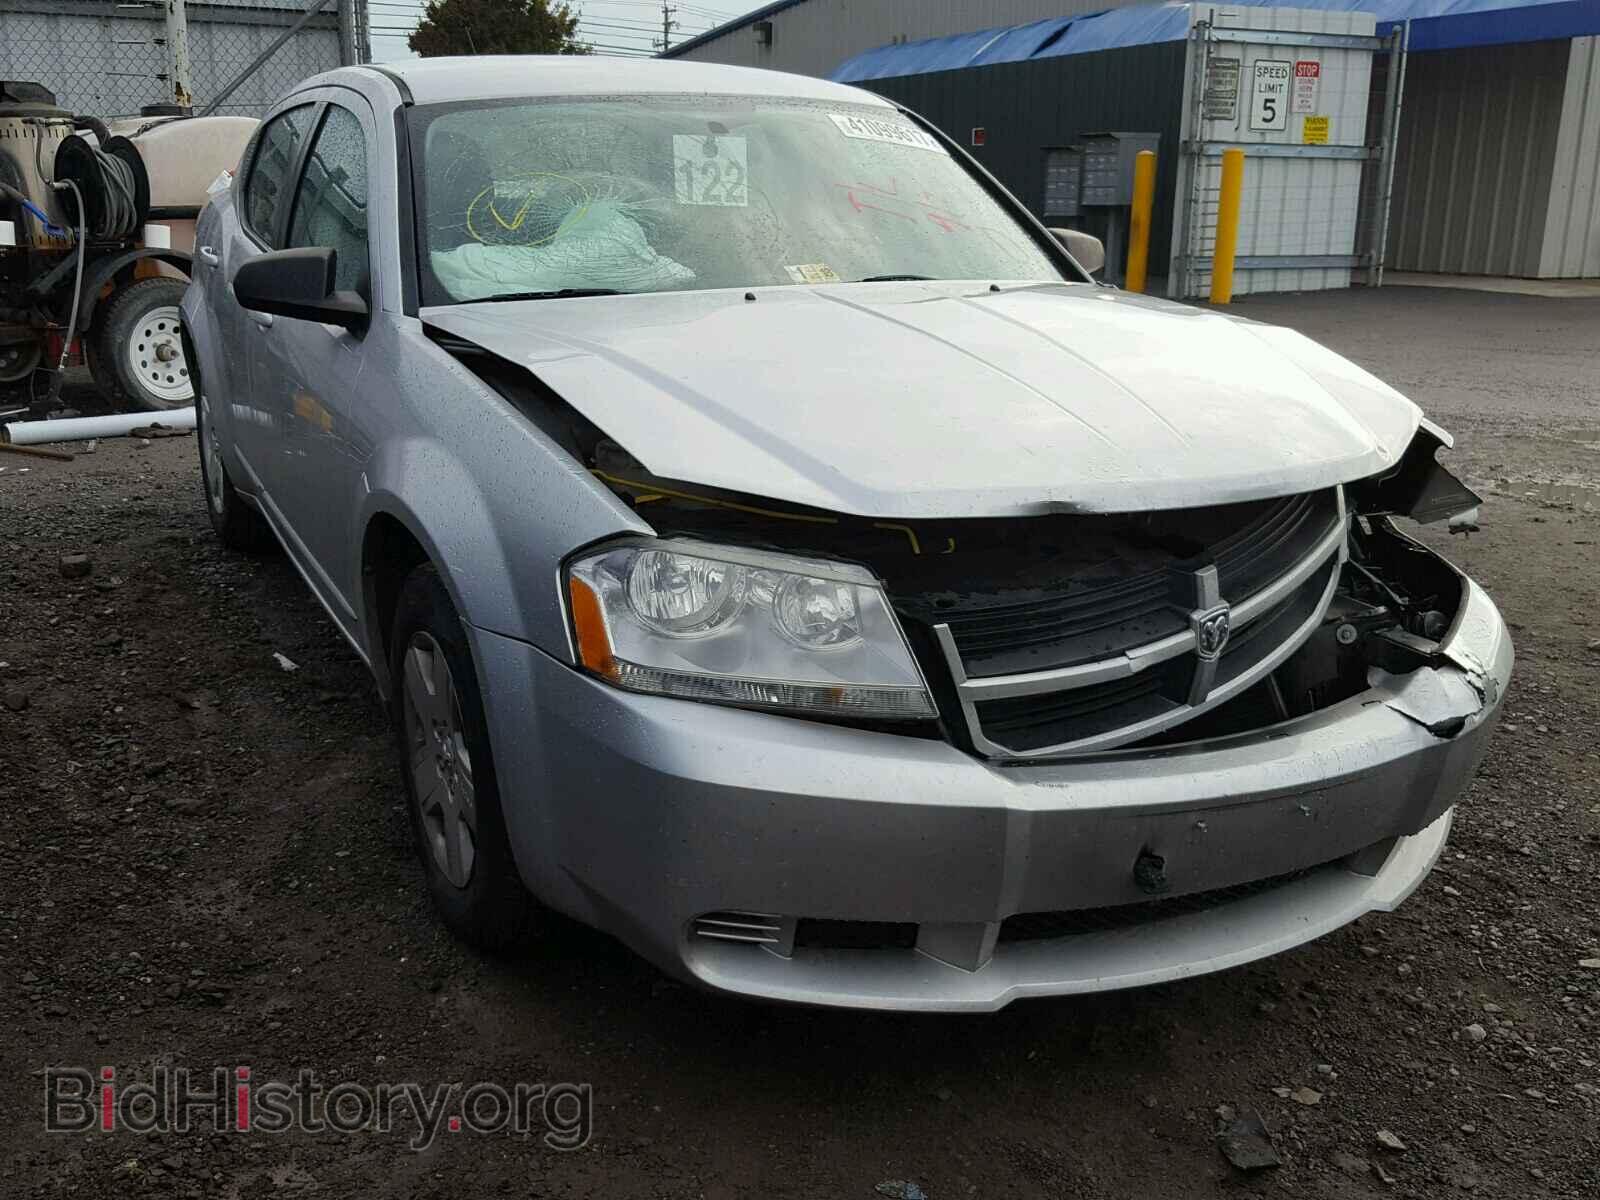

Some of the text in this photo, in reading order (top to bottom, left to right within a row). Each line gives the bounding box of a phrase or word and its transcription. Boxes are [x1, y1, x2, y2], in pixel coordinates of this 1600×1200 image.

[1256, 67, 1288, 79] SPEED
[1297, 64, 1318, 77] STOP
[1258, 84, 1284, 94] LIMIT
[1261, 98, 1276, 123] 5
[679, 158, 746, 202] 122
